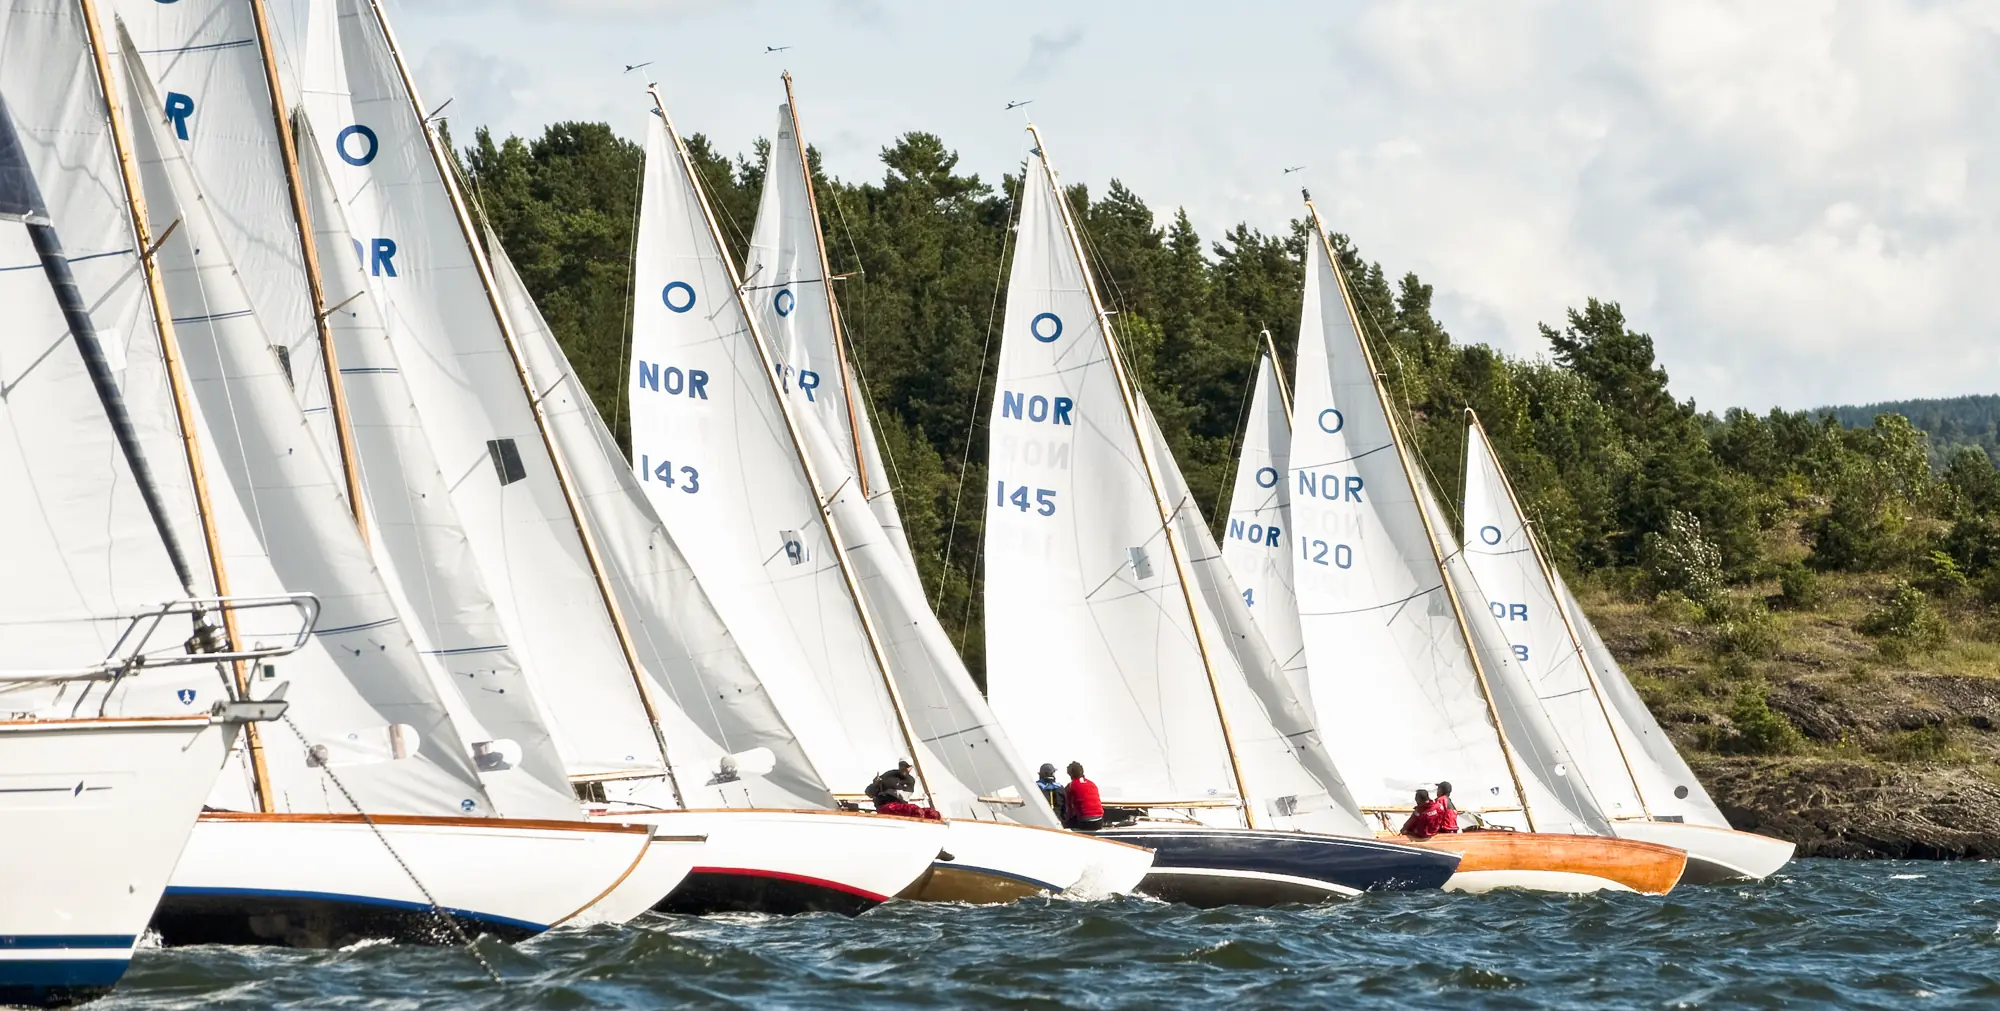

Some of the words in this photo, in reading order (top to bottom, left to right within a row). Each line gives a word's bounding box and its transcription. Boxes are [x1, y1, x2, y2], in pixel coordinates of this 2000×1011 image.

[639, 360, 709, 400] NOR
[1002, 390, 1073, 426] NOR
[642, 454, 699, 494] 143
[1299, 470, 1364, 503] NOR
[997, 481, 1056, 516] 145
[1229, 518, 1281, 548] NOR
[1302, 536, 1351, 569] 120
